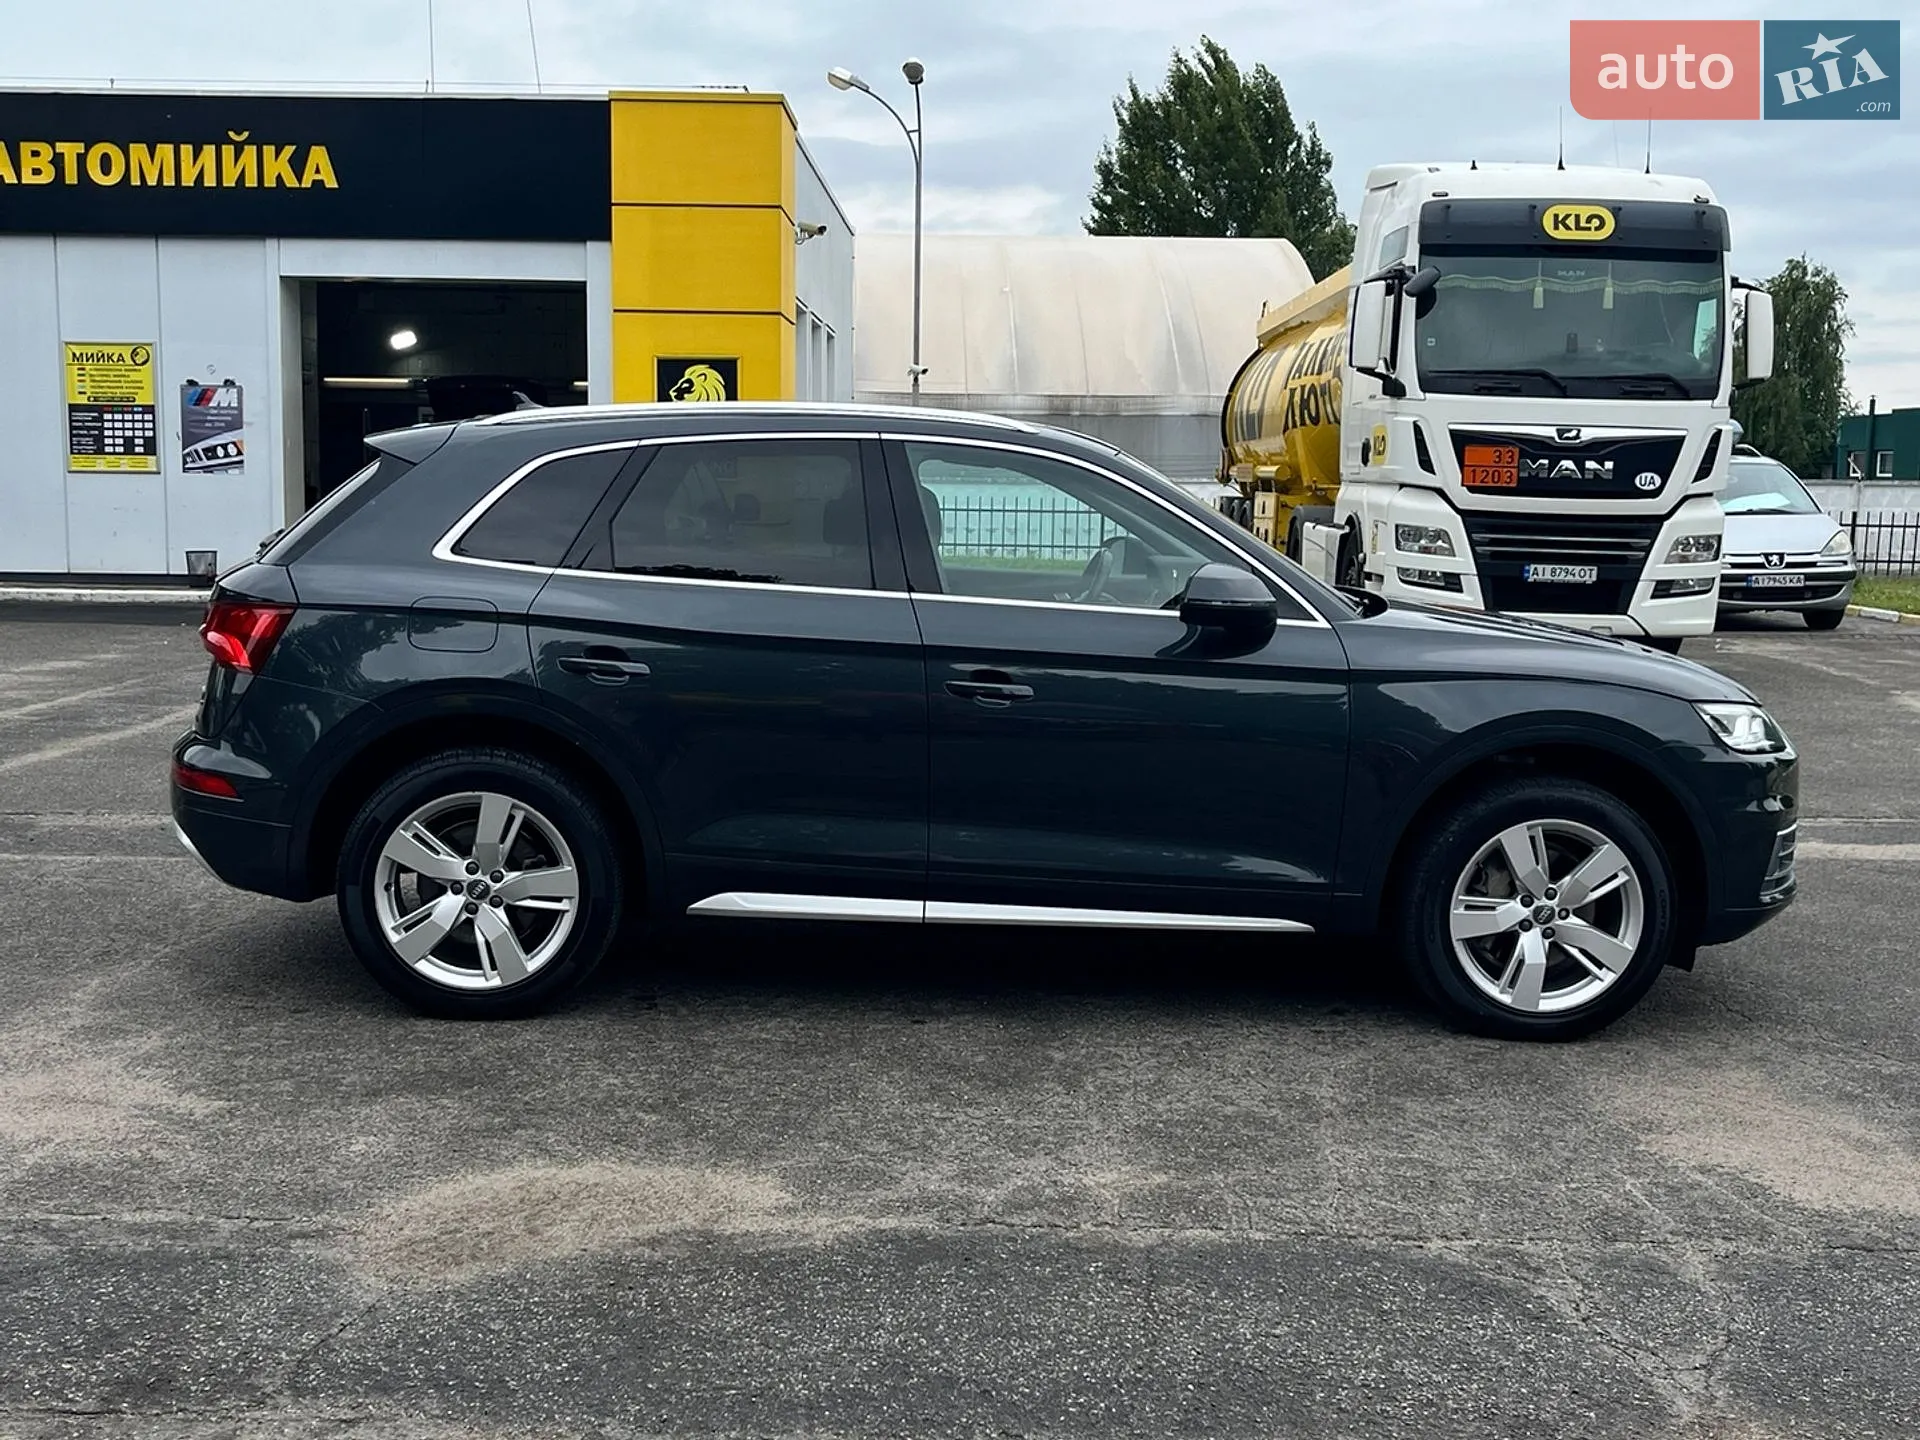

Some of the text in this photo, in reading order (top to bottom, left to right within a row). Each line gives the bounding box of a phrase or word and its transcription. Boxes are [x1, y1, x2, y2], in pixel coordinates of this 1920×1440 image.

[1553, 213, 1606, 232] KLO
[72, 350, 126, 363] МИЙКА
[1492, 448, 1515, 465] 33
[1470, 468, 1514, 485] 1203
[1518, 458, 1614, 480] MAN
[1639, 476, 1657, 488] UA
[1550, 567, 1576, 578] 8794
